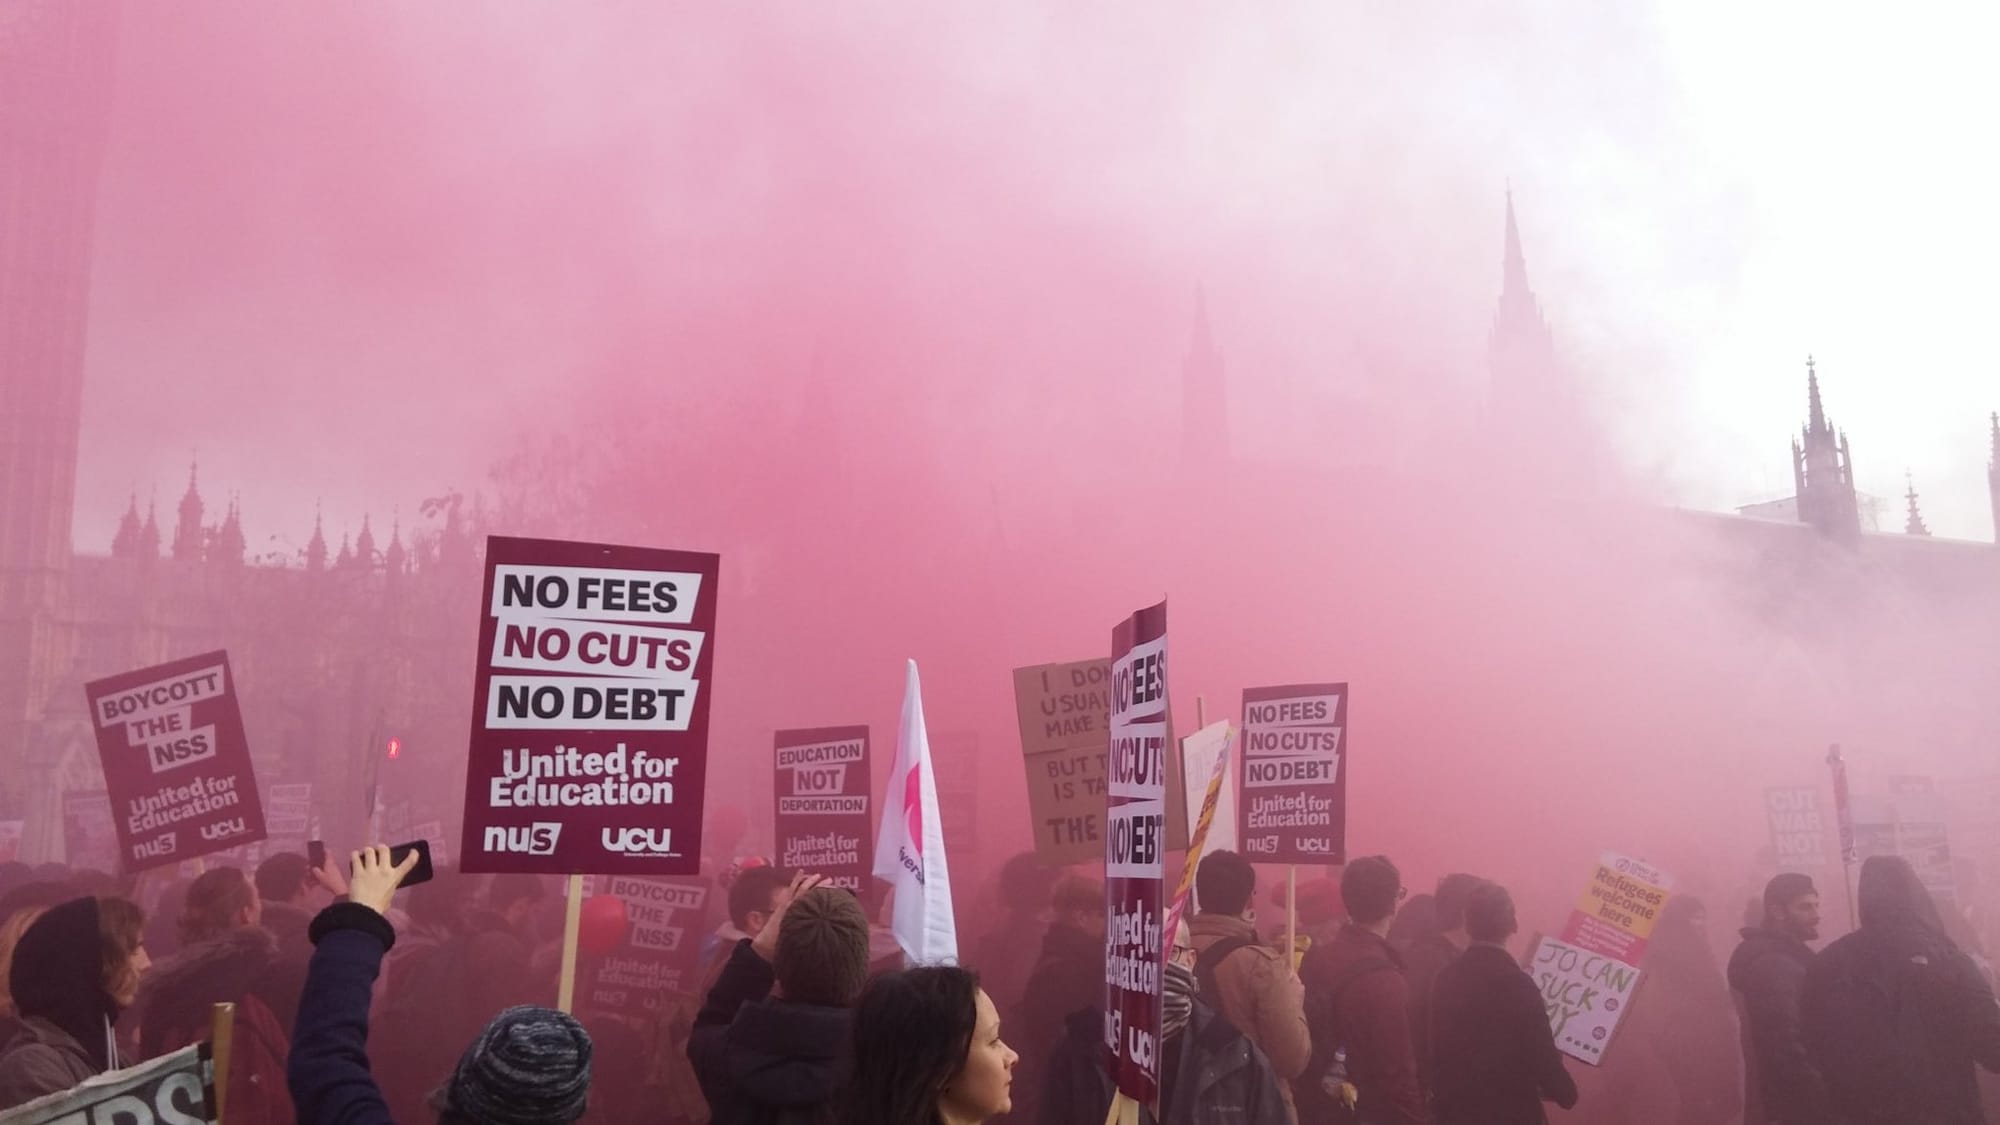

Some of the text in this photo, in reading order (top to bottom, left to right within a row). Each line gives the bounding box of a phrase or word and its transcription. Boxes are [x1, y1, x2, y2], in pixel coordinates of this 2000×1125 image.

[502, 574, 678, 614] NO FEES
[503, 624, 692, 672] NO CUTS
[1041, 670, 1049, 693] I
[1112, 667, 1128, 716] NO
[102, 672, 218, 720] BOYCOTT
[497, 685, 685, 721] NO DEBT
[1248, 701, 1327, 724] NO FEES
[131, 713, 183, 739] THE
[1045, 715, 1094, 738] MAKE
[154, 734, 208, 766] NSS
[1249, 732, 1335, 751] NO CUTS
[502, 743, 679, 780] United for
[779, 743, 860, 765] EDUCATION
[1111, 738, 1127, 783] NO
[1047, 756, 1089, 778] BUT
[1249, 760, 1332, 782] NO DEBT
[490, 774, 673, 807] Education
[797, 769, 840, 790] NOT
[128, 776, 207, 815] United
[206, 775, 237, 795] for
[1053, 782, 1075, 802] IS
[1252, 791, 1332, 813] United for
[1770, 789, 1816, 810] CUT
[127, 790, 240, 835] Education
[781, 799, 863, 811] DEPORTATION
[1046, 814, 1099, 845] THE
[1247, 809, 1330, 828] Education
[1770, 812, 1822, 832] WAR
[132, 832, 176, 860] nus
[483, 822, 671, 855] nus ucu
[787, 832, 859, 853] United for
[1108, 817, 1125, 864] NO
[1246, 834, 1279, 853] nus
[1776, 833, 1824, 854] NOT
[783, 848, 858, 868] Education
[614, 881, 700, 905] BOYCOTT
[1595, 867, 1662, 905] Refugees
[629, 903, 665, 924] THE
[1591, 885, 1654, 920] welcome
[1598, 902, 1633, 927] here
[636, 927, 675, 946] NSS
[1538, 943, 1635, 993] JO CAN
[1539, 972, 1599, 1011] SUCK
